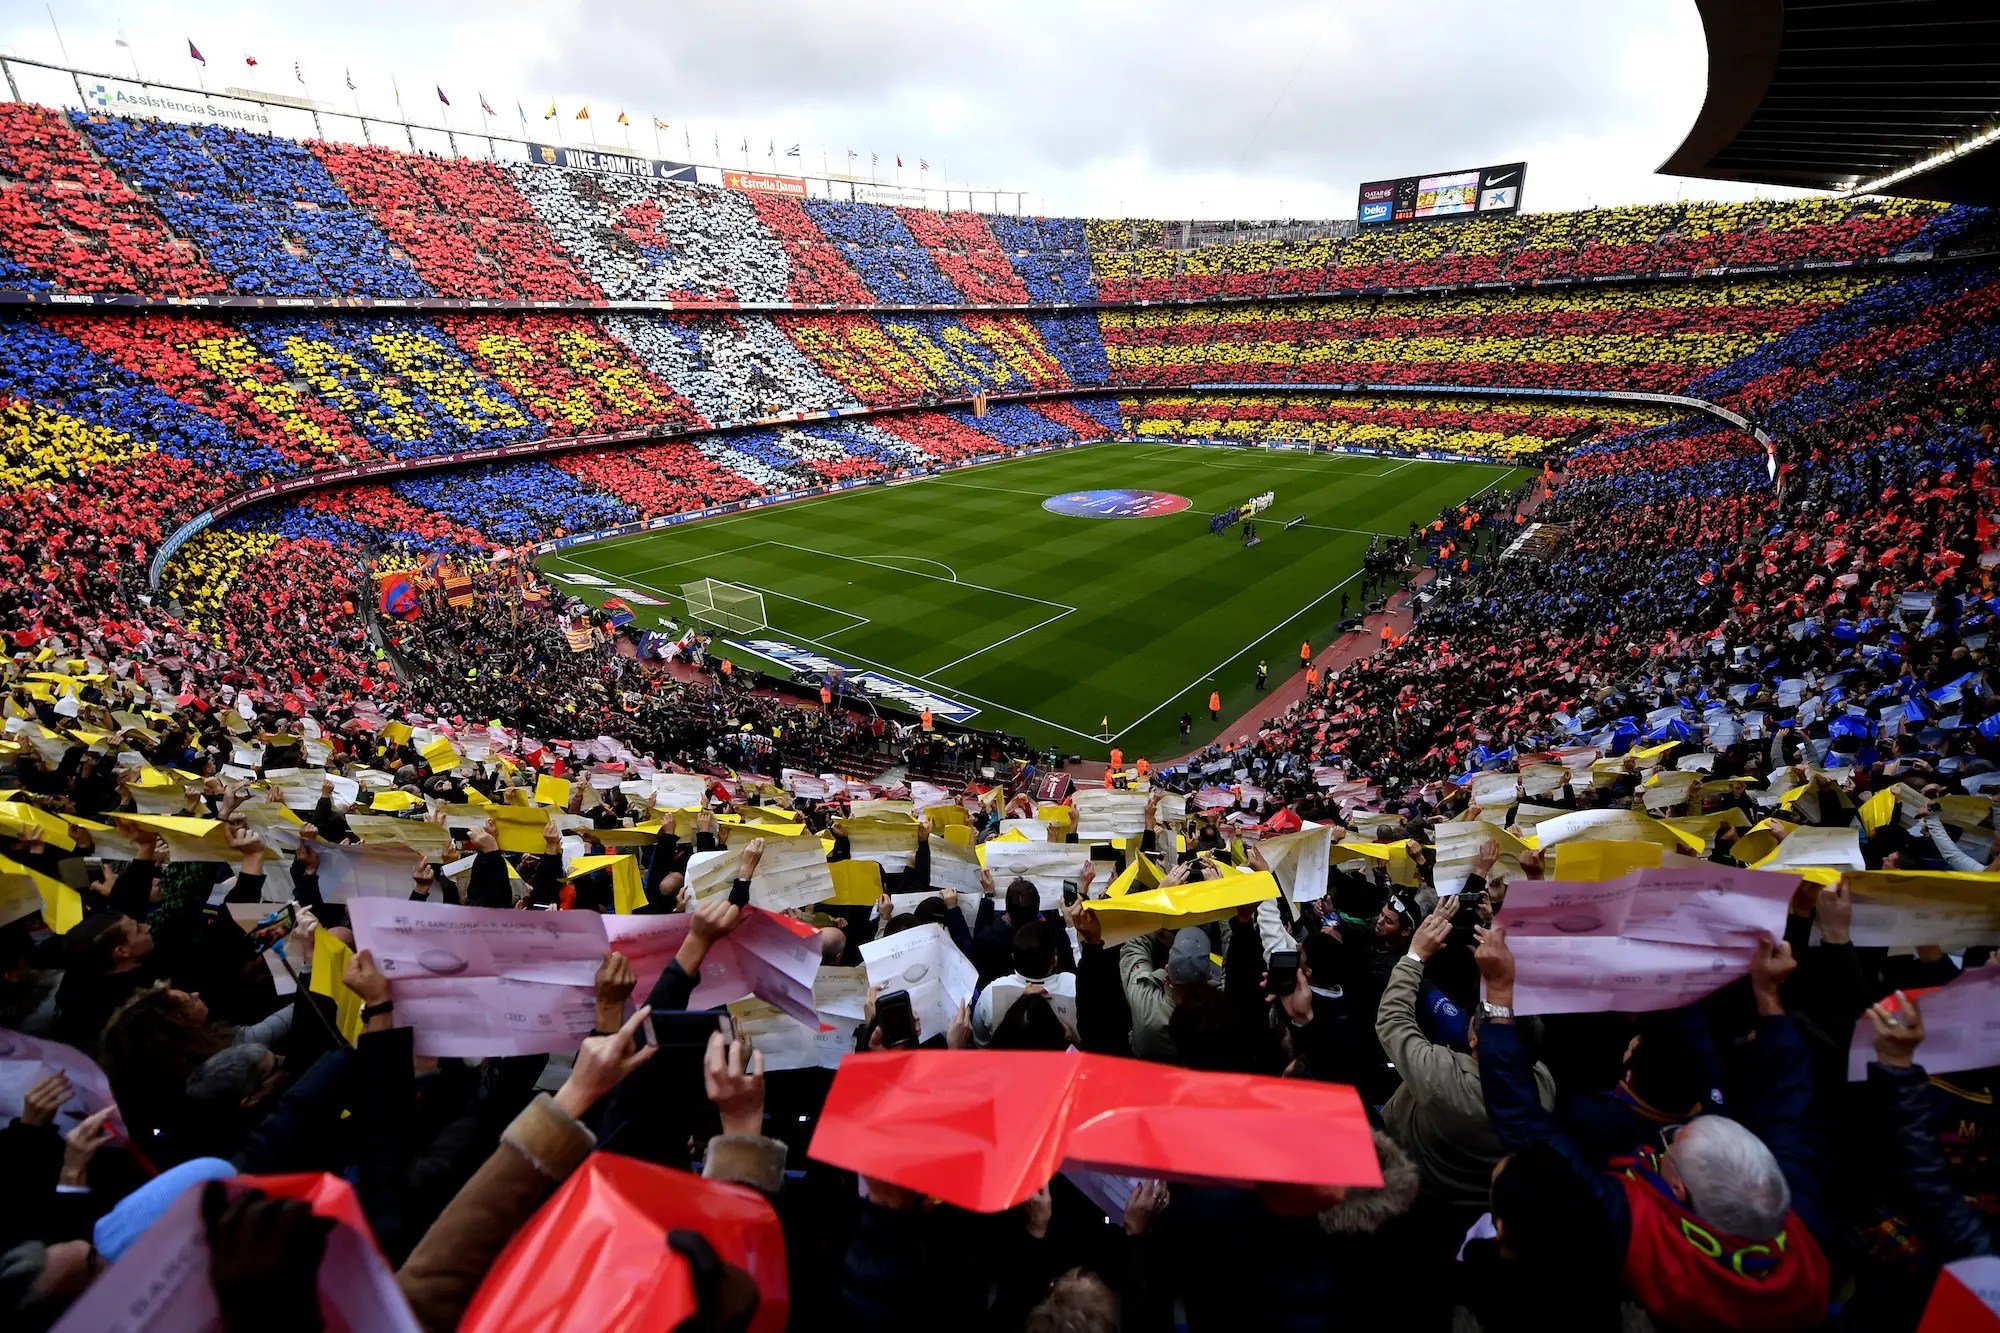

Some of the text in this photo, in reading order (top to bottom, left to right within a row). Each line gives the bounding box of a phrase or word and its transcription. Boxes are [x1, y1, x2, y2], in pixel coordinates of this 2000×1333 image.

[116, 90, 205, 115] Assistència
[565, 150, 655, 177] NIKE.COM/FCB
[740, 175, 804, 193] Estrella Damm
[1364, 190, 1384, 198] QATAR
[1364, 205, 1387, 215] beko
[1729, 265, 1779, 274] FCBARCELONA.COM
[50, 295, 94, 304] NIKE.COM/FCB
[383, 958, 397, 971] 2
